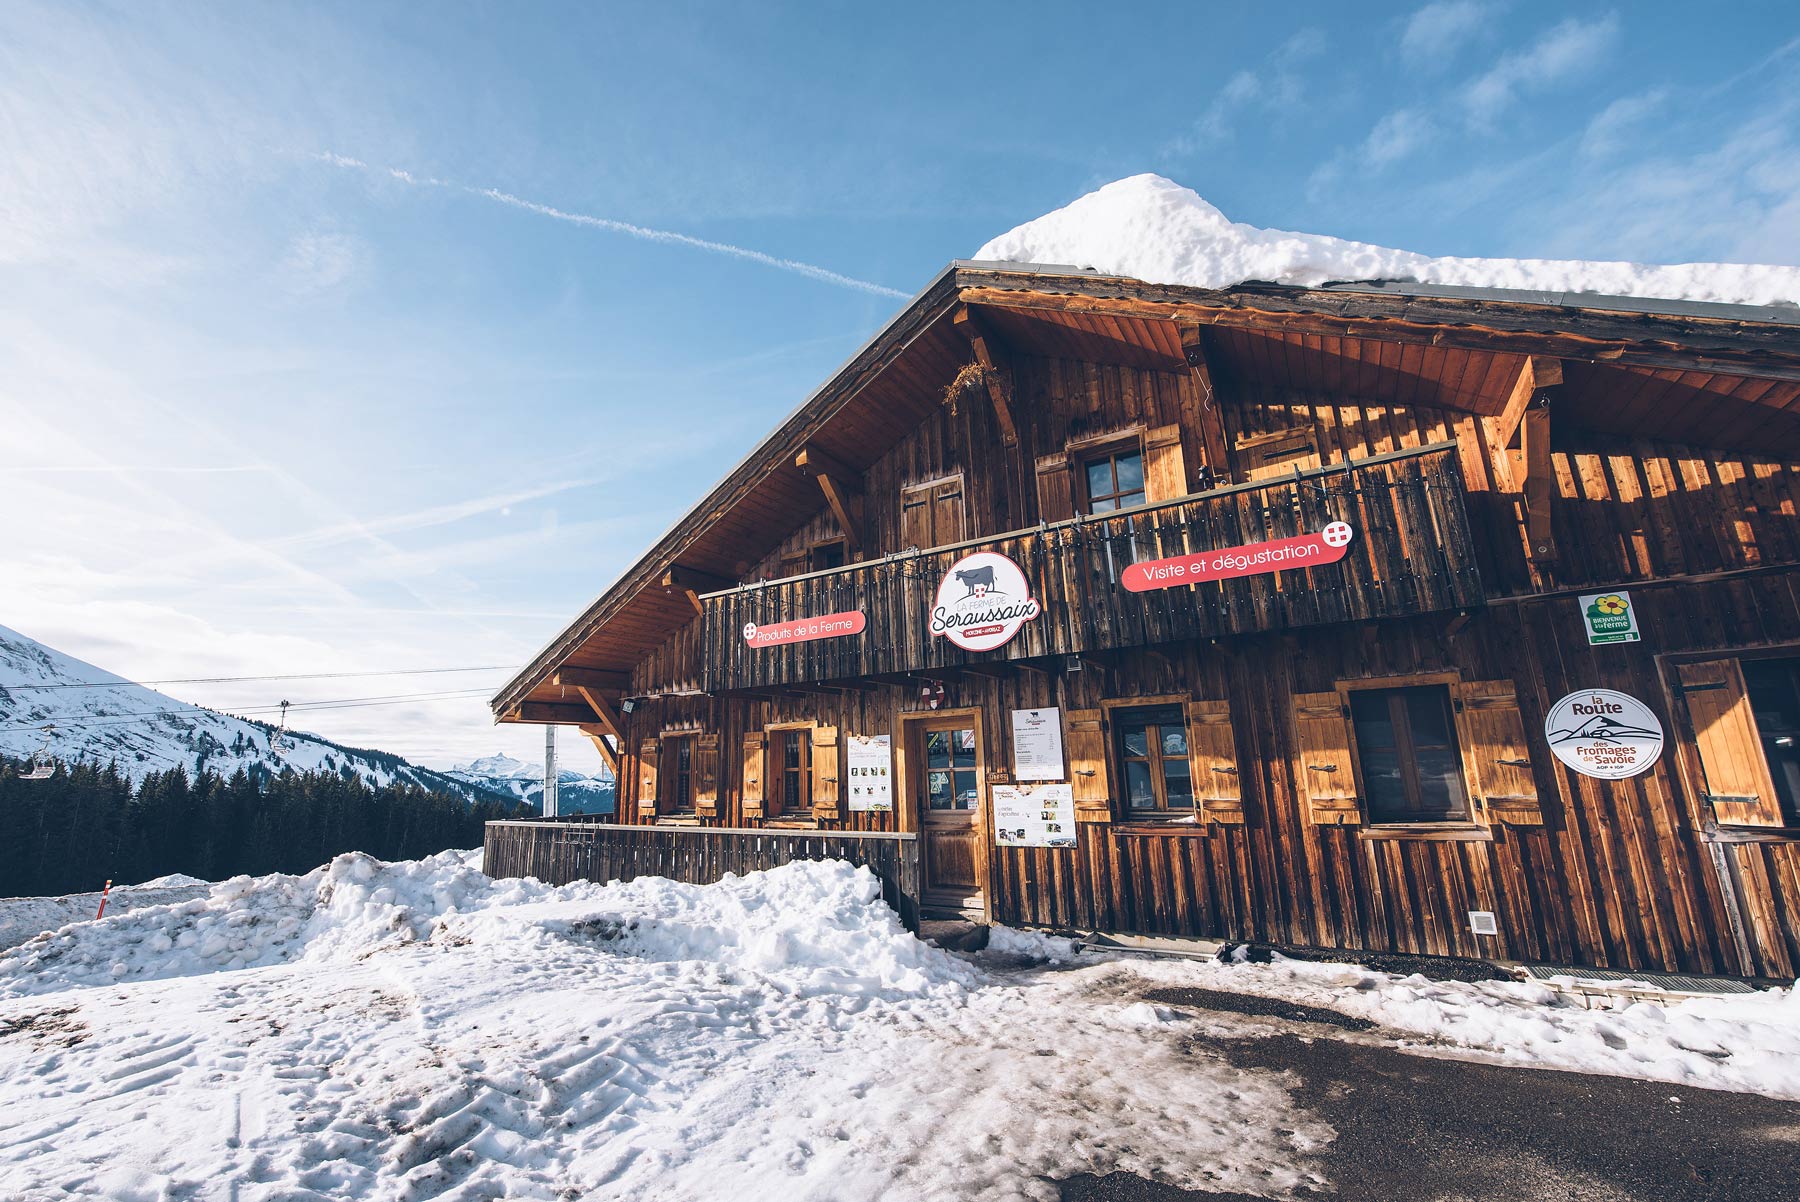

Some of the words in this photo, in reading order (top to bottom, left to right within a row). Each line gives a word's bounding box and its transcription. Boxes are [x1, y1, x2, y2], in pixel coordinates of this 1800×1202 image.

[1142, 563, 1185, 581] Visite
[1190, 560, 1207, 574] et
[1212, 543, 1319, 570] dégustation
[956, 603, 967, 612] LA
[969, 598, 995, 610] FERME
[996, 596, 1007, 605] DE
[932, 599, 1036, 631] Seraussaix
[757, 629, 792, 642] Produits
[793, 627, 806, 637] de
[809, 624, 818, 634] la
[820, 619, 853, 632] Ferme
[1603, 621, 1628, 629] ferme
[1591, 695, 1603, 705] la
[1571, 702, 1623, 715] Route
[1576, 746, 1637, 757] Fromages
[1594, 754, 1636, 765] Savoie
